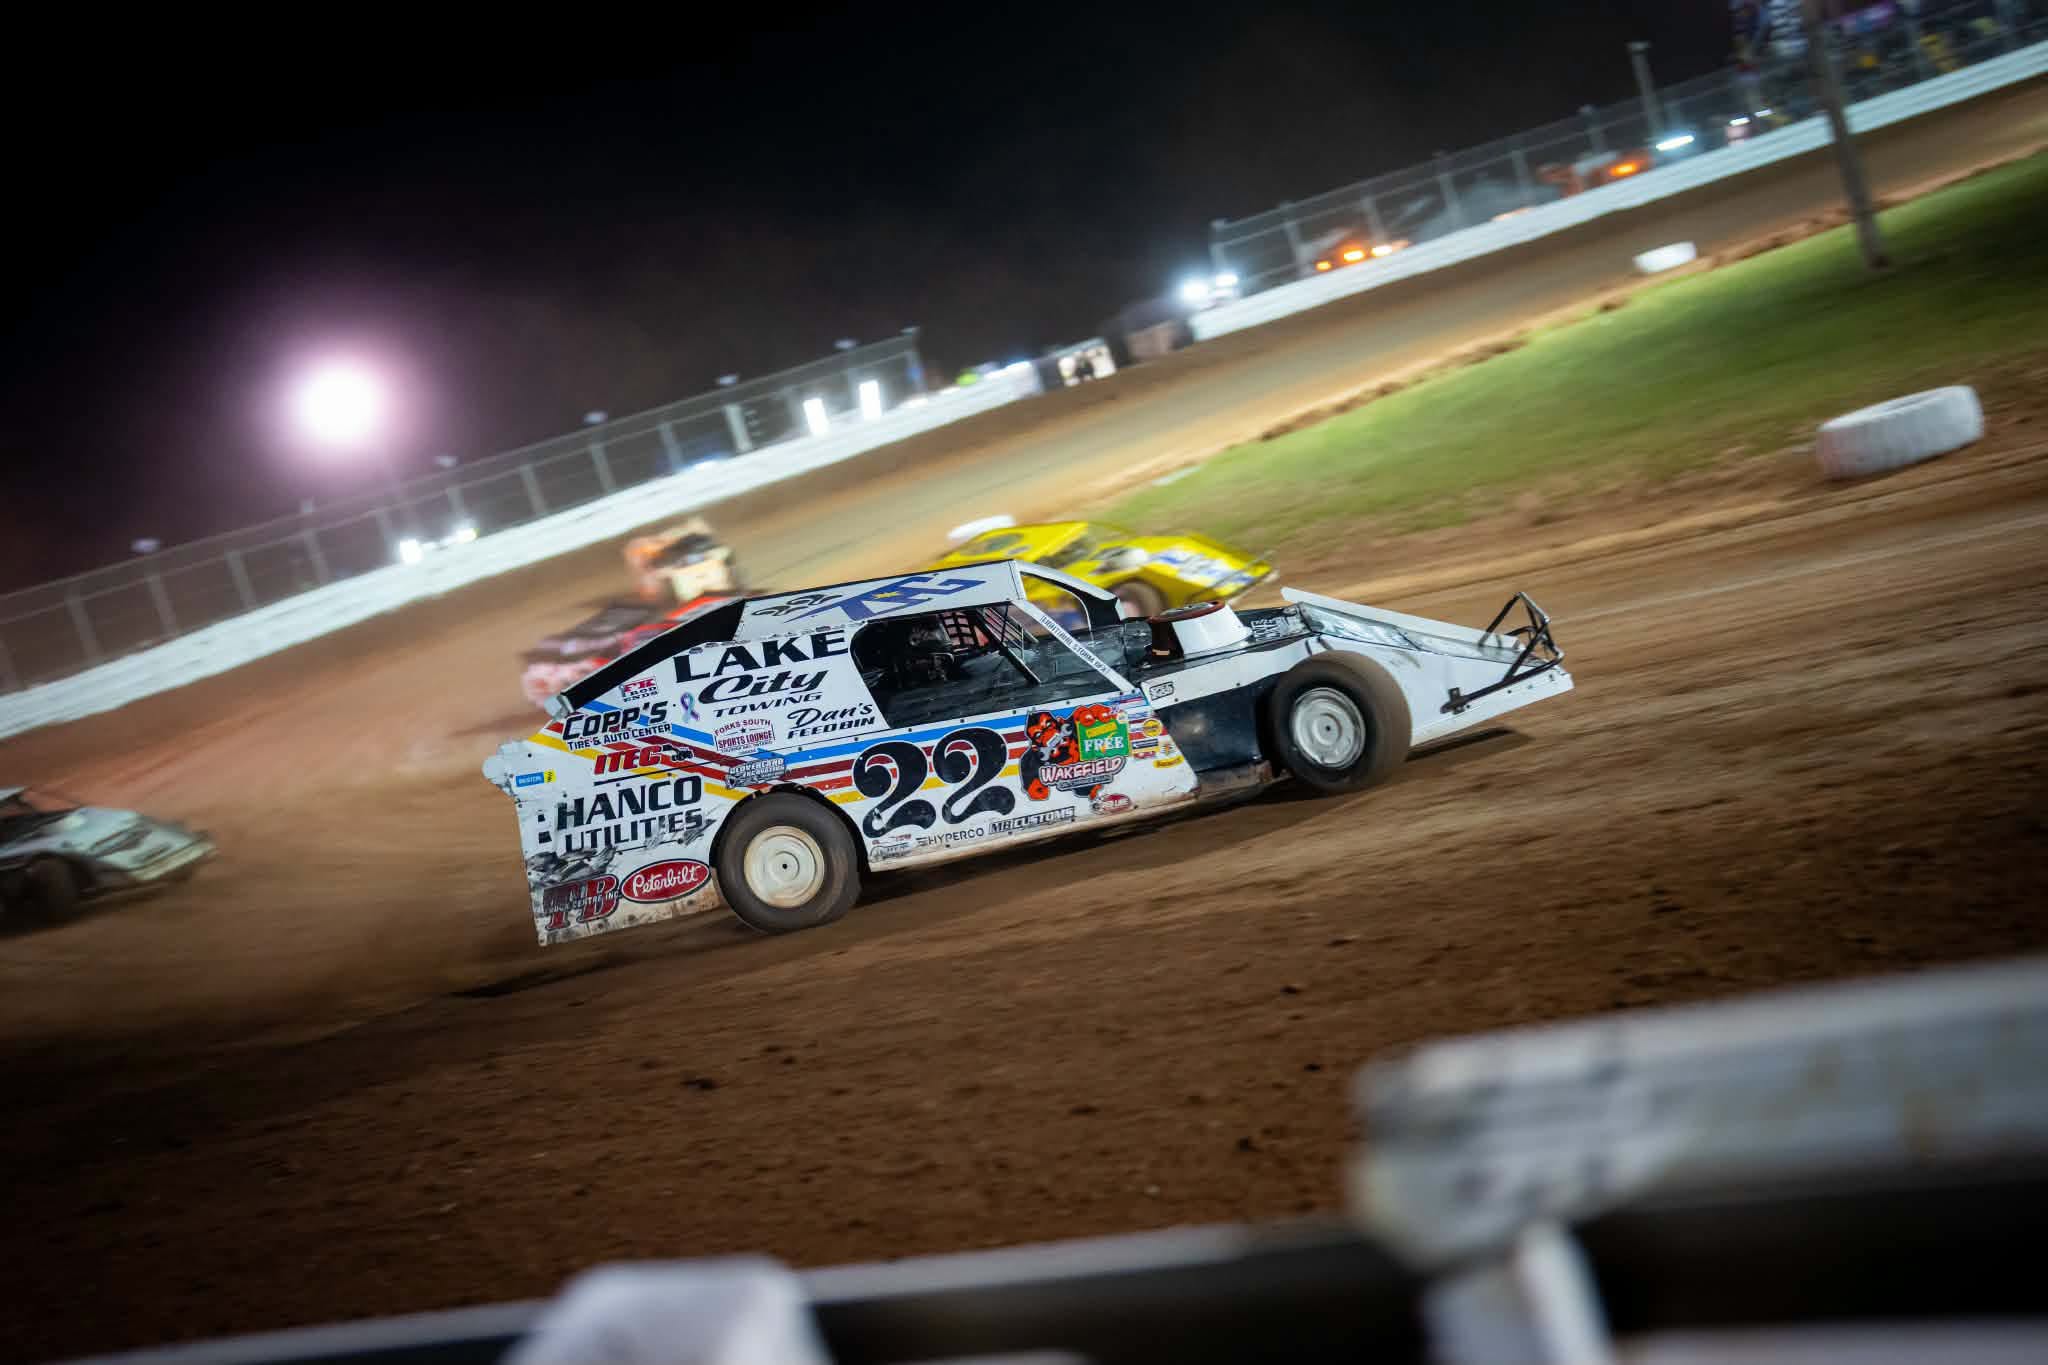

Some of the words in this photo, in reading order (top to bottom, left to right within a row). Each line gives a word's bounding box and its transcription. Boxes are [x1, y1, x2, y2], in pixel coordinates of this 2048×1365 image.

[673, 629, 849, 683] LAKE
[623, 691, 658, 702] ENDS
[629, 686, 657, 697] ROD
[698, 670, 829, 704] City
[714, 692, 822, 718] TOWING
[787, 702, 873, 728] Dan's
[563, 701, 668, 740] COPP'S
[714, 721, 741, 736] FORKS
[742, 718, 771, 727] SOUTH
[567, 739, 591, 751] TIRE
[591, 736, 601, 746] &
[604, 732, 630, 744] AUTO
[632, 723, 672, 739] CENTER
[718, 735, 745, 749] SPORTS
[746, 730, 773, 743] LOUNGE
[1084, 736, 1125, 753] FREE
[594, 745, 662, 775] ITEC
[1040, 757, 1122, 783] WAKEFIELD
[852, 727, 1016, 839] 22
[556, 775, 702, 831] HANCO
[565, 808, 703, 853] UTILITIES
[927, 827, 984, 846] HYPERCO
[632, 865, 701, 897] Peterbilt
